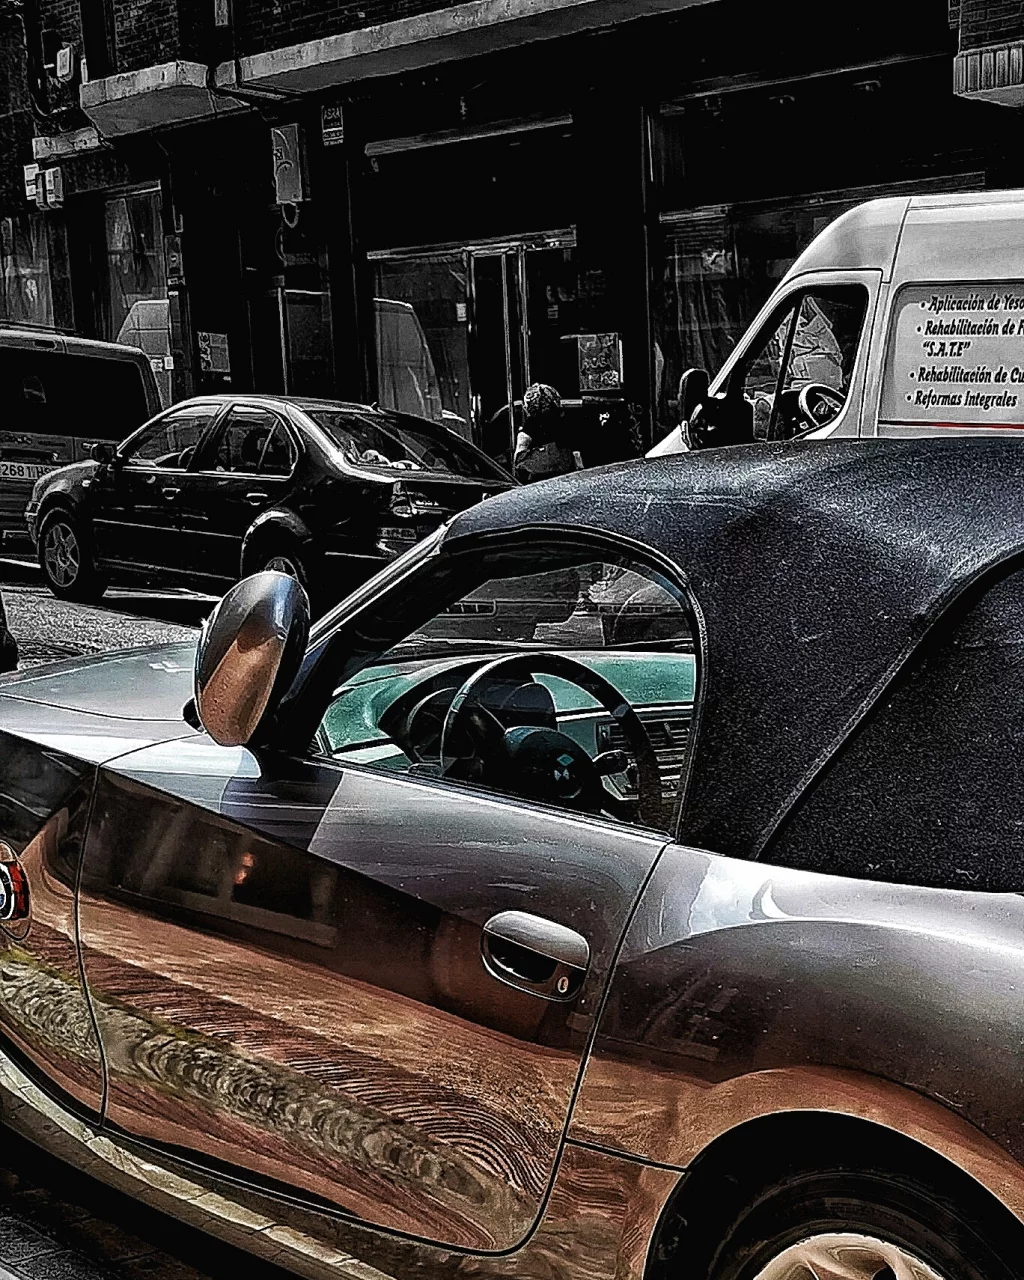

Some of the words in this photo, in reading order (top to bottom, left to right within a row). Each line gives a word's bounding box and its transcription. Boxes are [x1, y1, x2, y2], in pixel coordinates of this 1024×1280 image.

[928, 294, 984, 314] Aplicación
[987, 294, 999, 310] de
[924, 318, 999, 336] Rehabilitación
[1002, 318, 1015, 335] de
[918, 367, 991, 383] Rehabilitación
[994, 367, 1007, 382] de
[914, 389, 962, 409] Reformas
[964, 391, 1017, 410] Integrales
[1, 464, 31, 478] 2681
